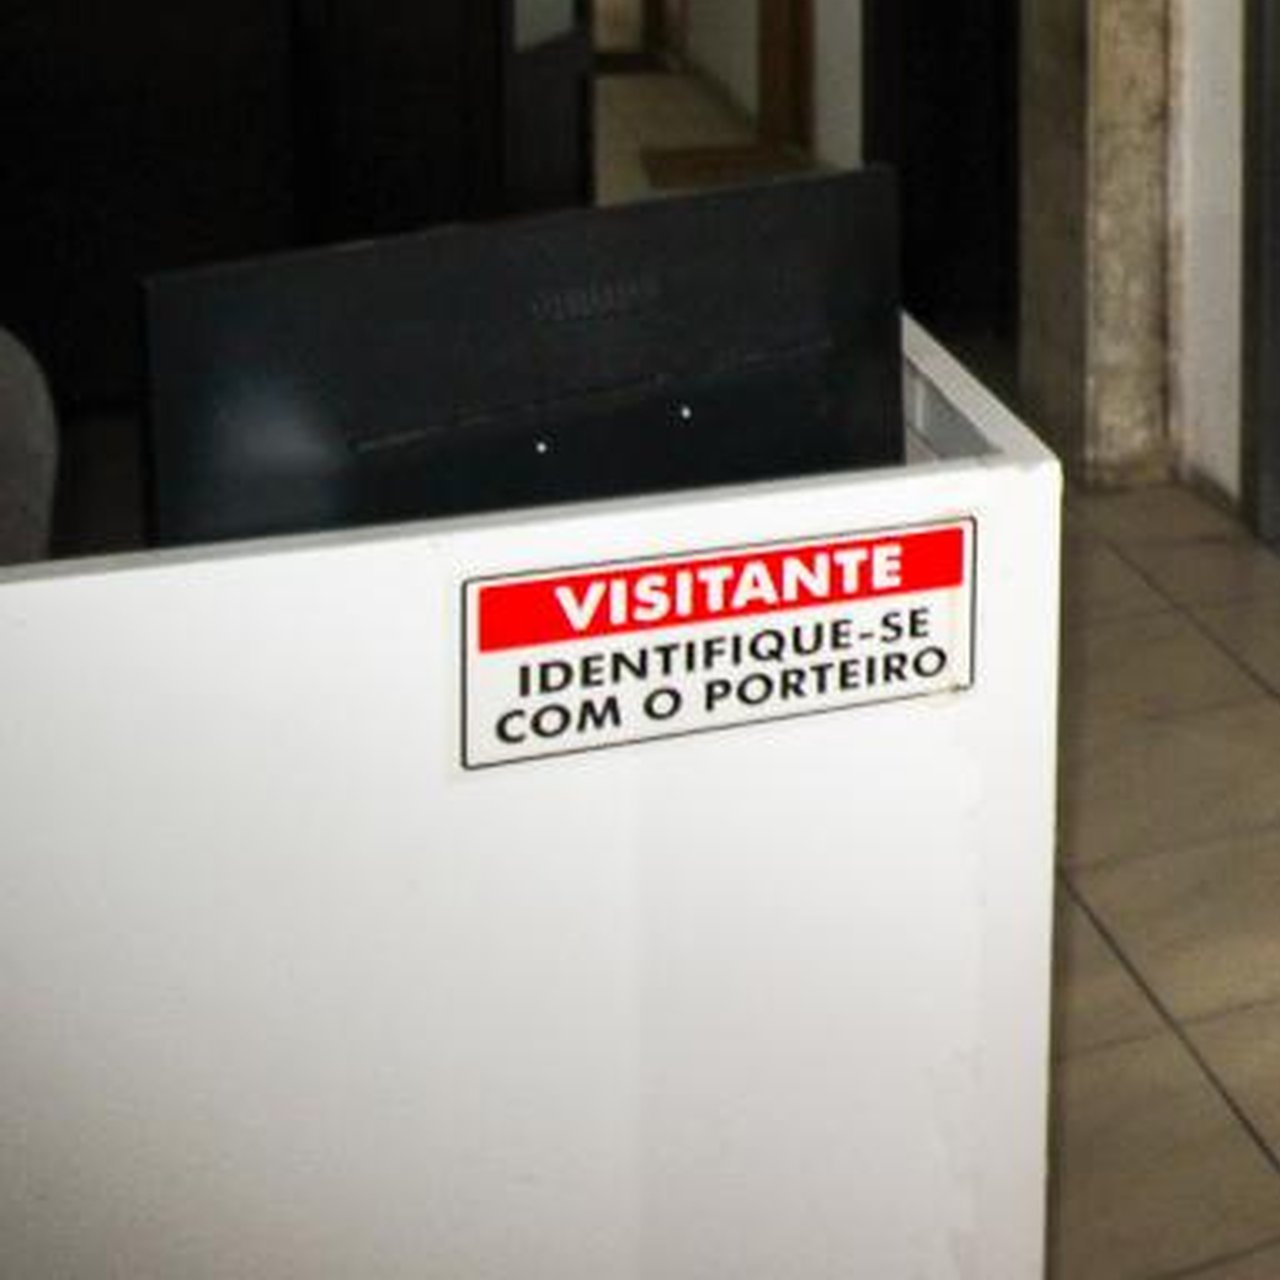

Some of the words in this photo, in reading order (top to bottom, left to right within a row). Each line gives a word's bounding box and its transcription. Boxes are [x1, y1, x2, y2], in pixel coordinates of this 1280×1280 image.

[555, 545, 903, 630] VISITANTE
[495, 696, 622, 743] COM
[643, 687, 682, 721] O
[704, 646, 947, 711] PORTEIRO
[518, 607, 931, 696] IDENTIFIQUE-SE
